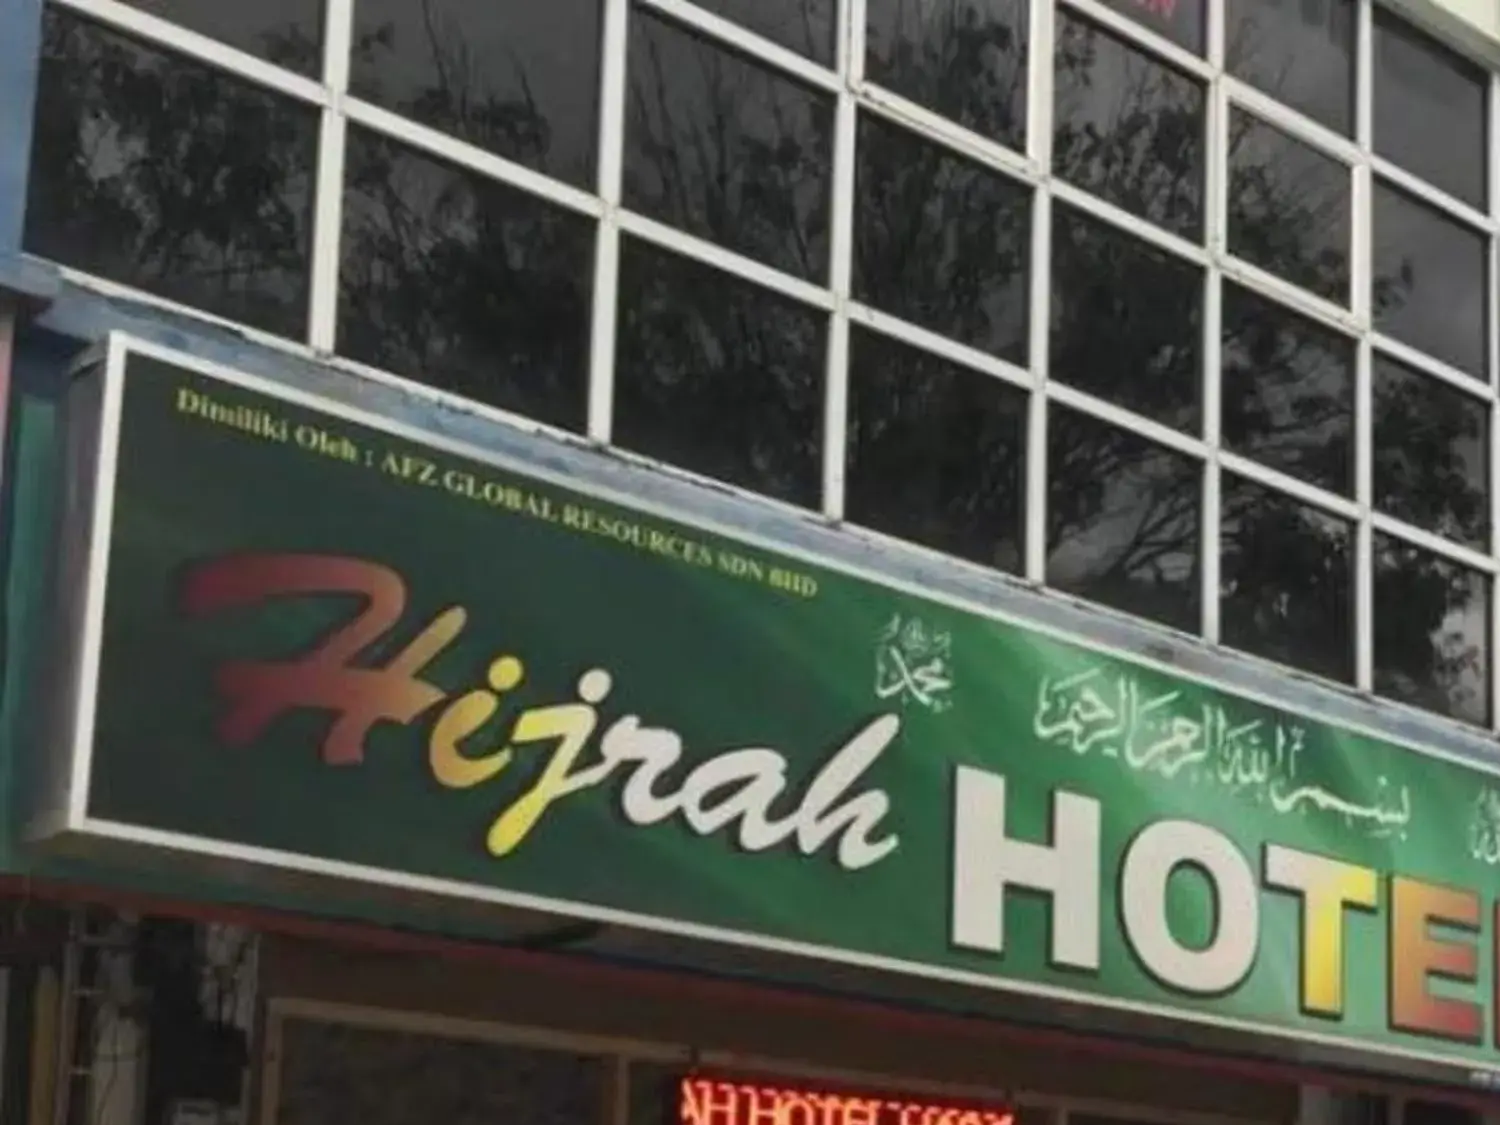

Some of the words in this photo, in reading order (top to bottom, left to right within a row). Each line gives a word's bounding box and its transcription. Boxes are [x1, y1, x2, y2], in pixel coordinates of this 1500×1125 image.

[176, 386, 289, 444] Dimiliki
[294, 424, 358, 463] Oleh
[381, 451, 438, 487] AFZ
[442, 469, 560, 523] GLOBAL
[561, 501, 713, 567] RESOURCES
[716, 552, 765, 583] SDN
[768, 565, 819, 599] BHD
[179, 552, 899, 869] Hijrah
